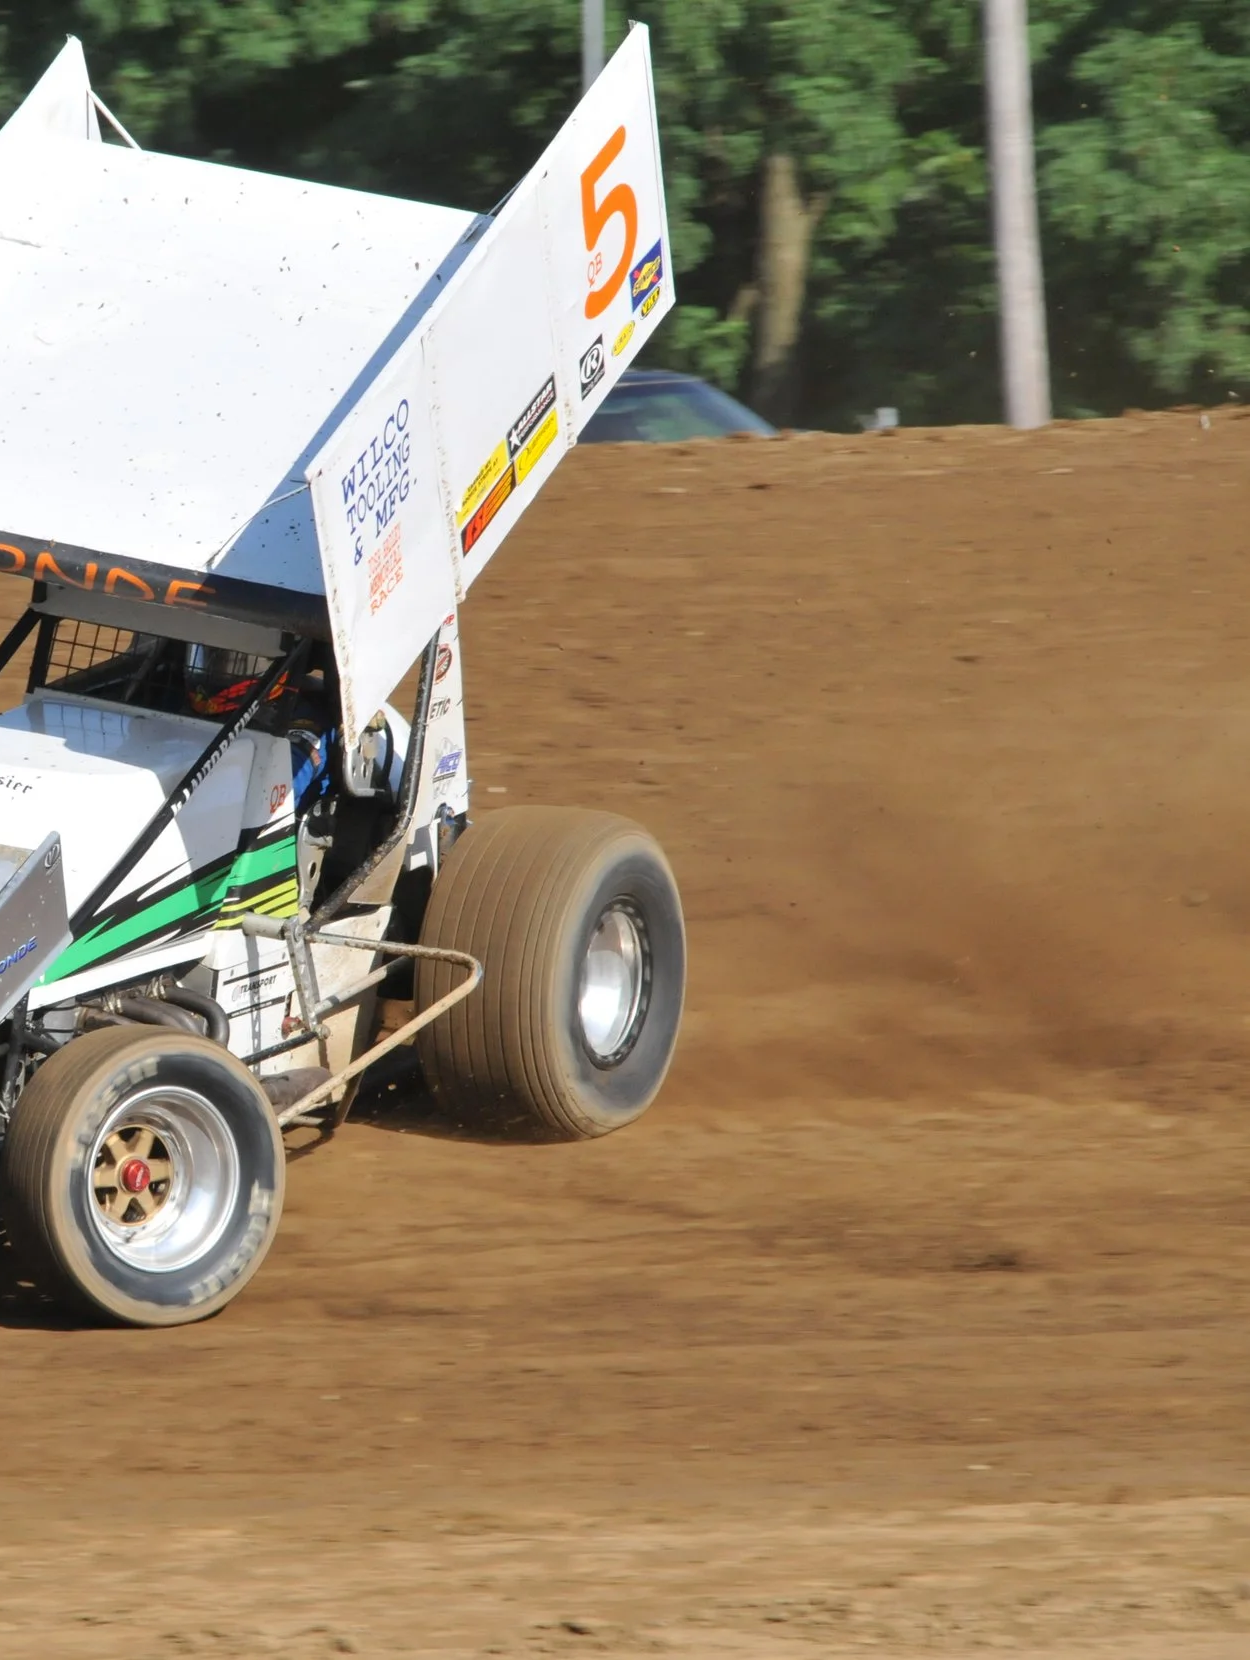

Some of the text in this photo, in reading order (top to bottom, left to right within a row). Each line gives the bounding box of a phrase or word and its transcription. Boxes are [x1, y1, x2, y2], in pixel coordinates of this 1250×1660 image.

[580, 125, 638, 320] 5
[587, 251, 603, 289] QB
[632, 255, 662, 298] SUNOCO
[516, 379, 554, 434] ALLSTAR
[342, 398, 409, 505] WILCO
[346, 432, 411, 536] TOOLING
[354, 535, 363, 566] &
[376, 468, 418, 539] MFG.
[369, 566, 405, 616] RACE
[269, 784, 287, 814] QB
[240, 974, 278, 994] TRANSPORT
